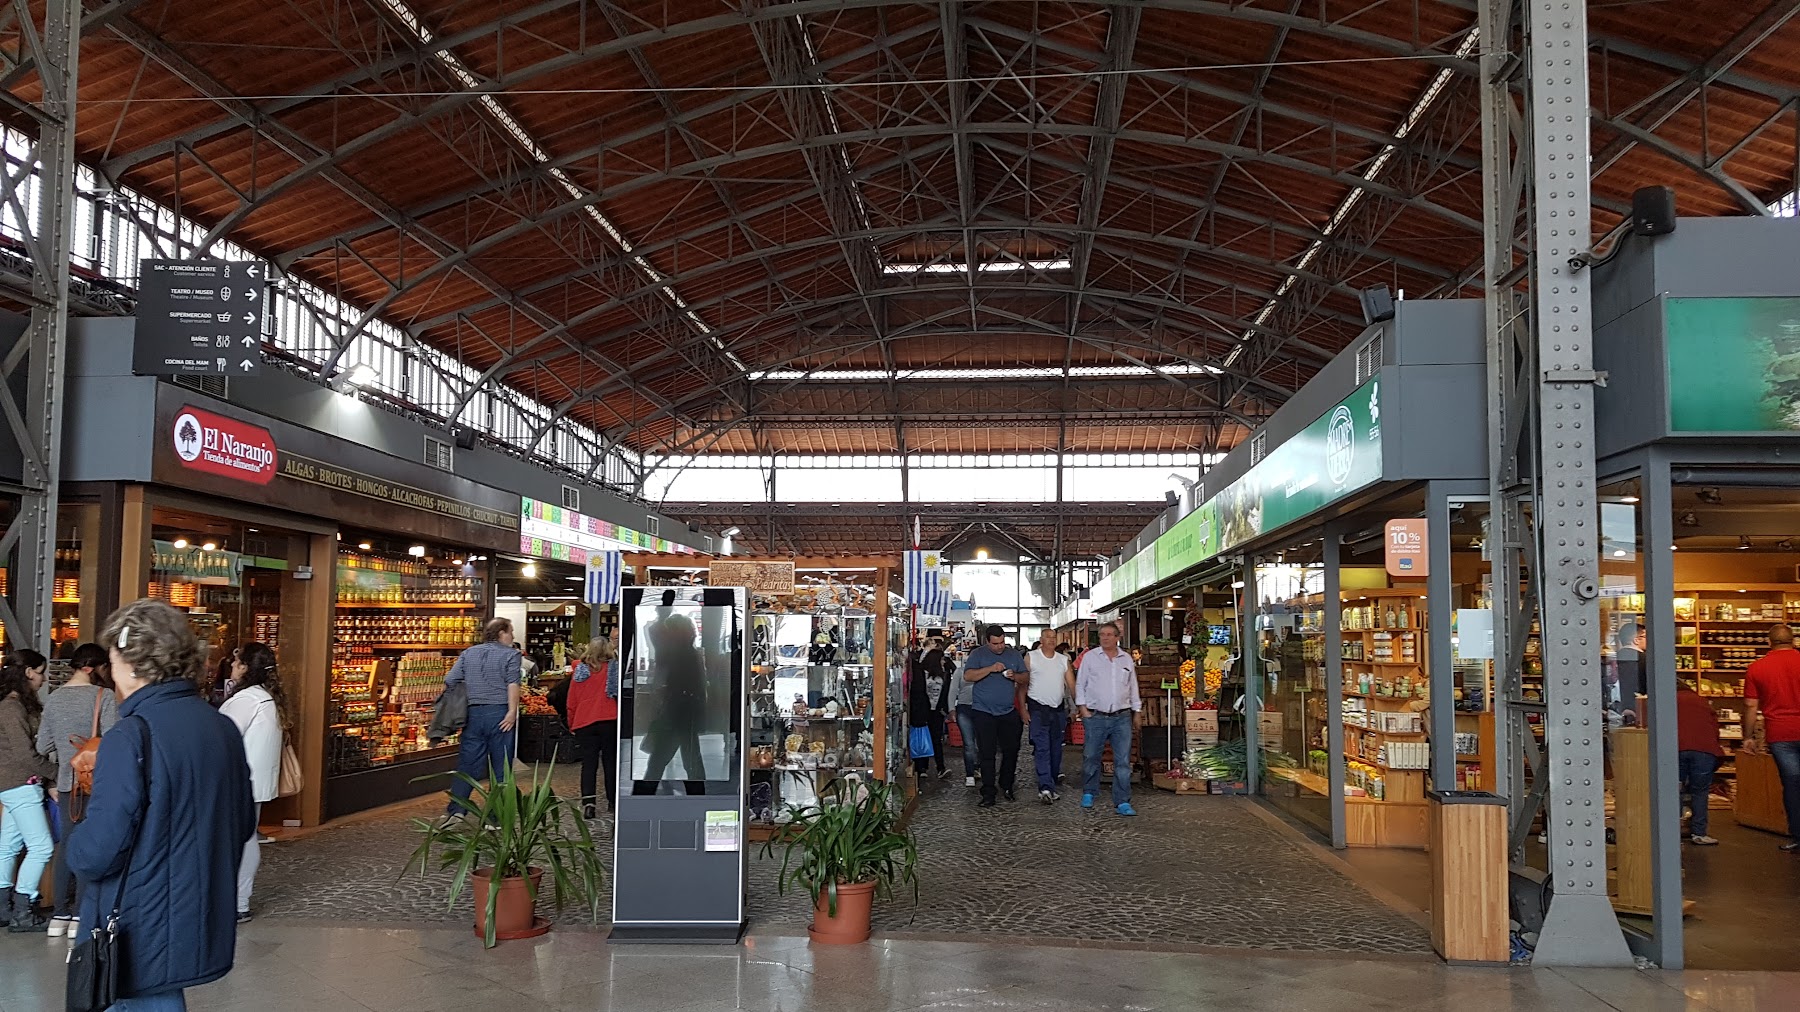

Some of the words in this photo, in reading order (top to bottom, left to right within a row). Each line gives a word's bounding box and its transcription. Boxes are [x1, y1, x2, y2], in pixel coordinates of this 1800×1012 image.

[203, 427, 218, 451] El
[221, 432, 273, 468] Naranjo
[203, 450, 225, 465] Tienda
[225, 455, 233, 466] de
[233, 457, 261, 473] alimentos
[285, 459, 314, 479] ALGAS
[319, 468, 352, 489] BROTES
[356, 478, 388, 498] HONGOS
[391, 488, 435, 509] ALCACHOFAS
[437, 499, 471, 518] PEPINILLOS
[473, 509, 498, 523] CHUCRUT
[1390, 524, 1408, 532] aquí
[755, 578, 792, 590] Piedritas
